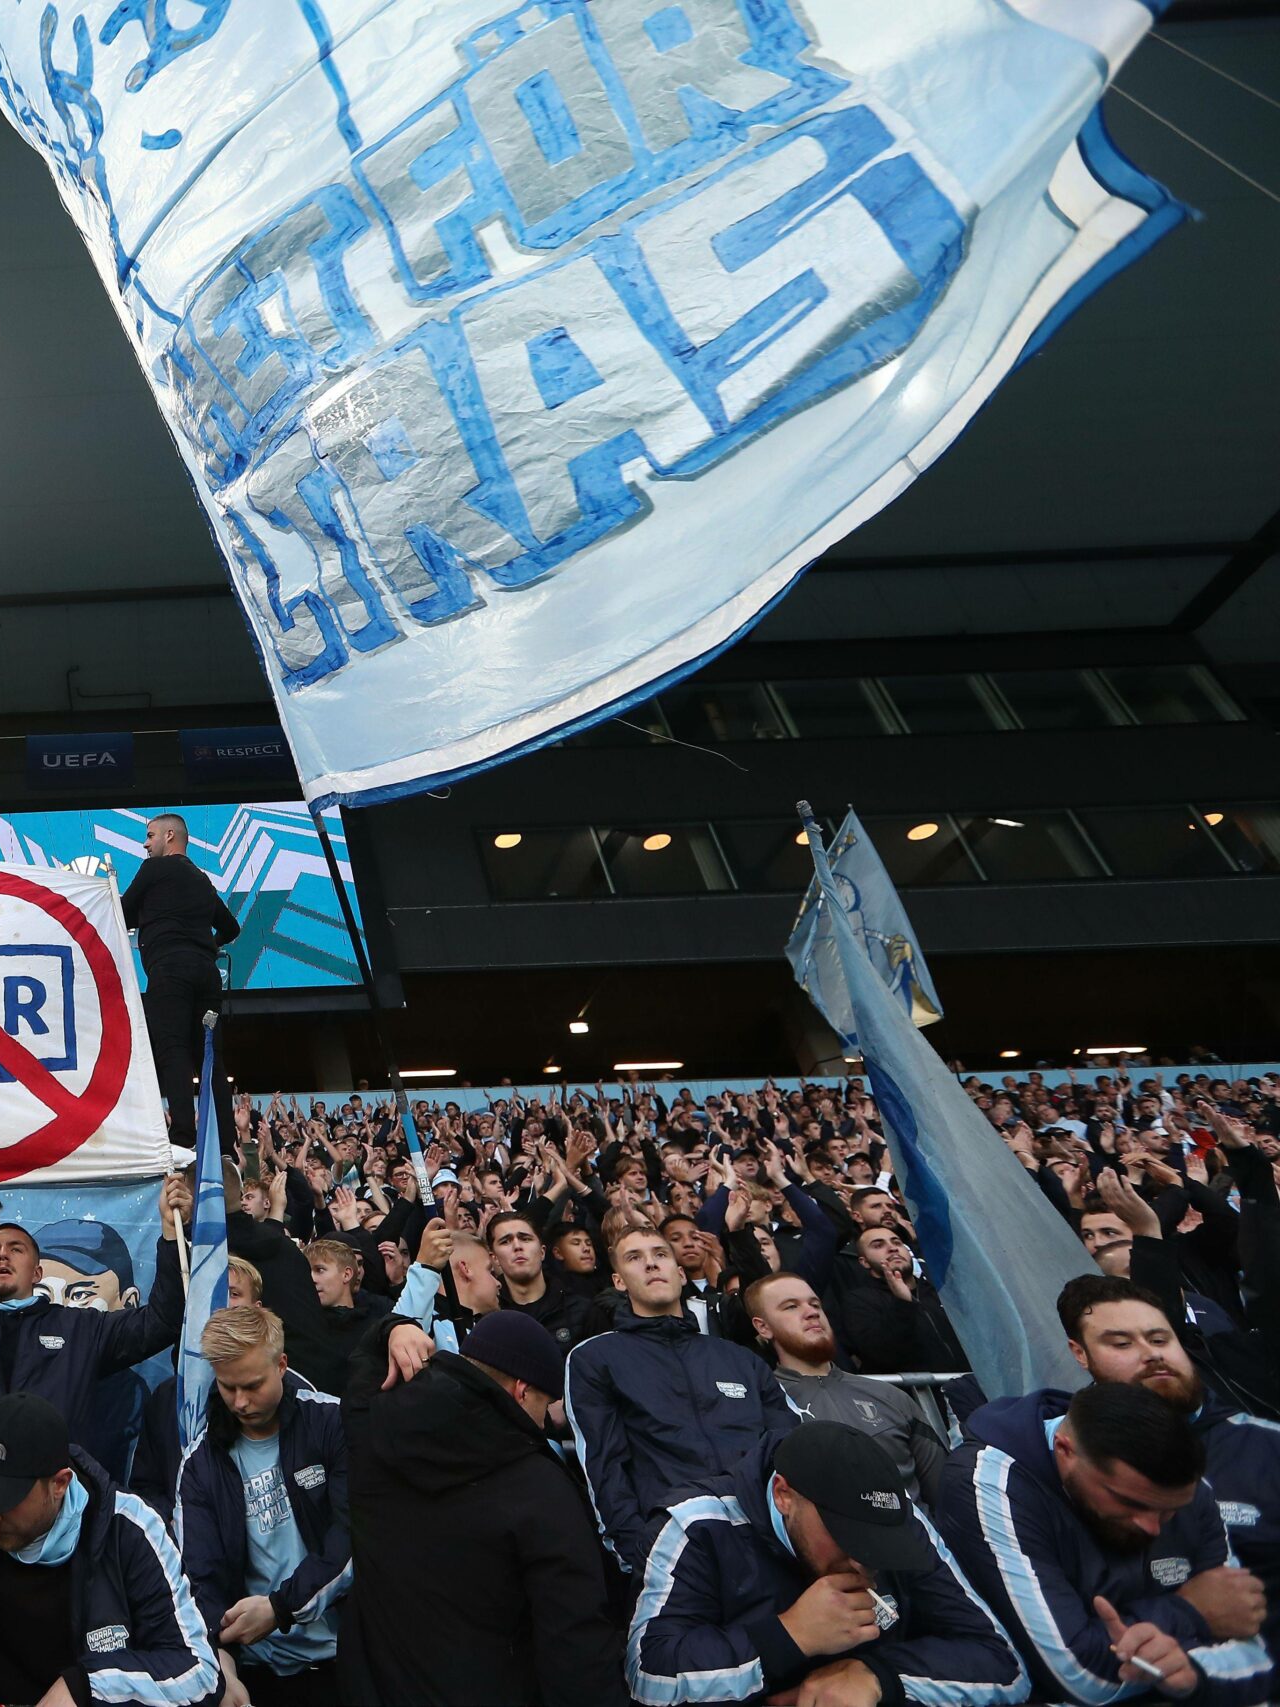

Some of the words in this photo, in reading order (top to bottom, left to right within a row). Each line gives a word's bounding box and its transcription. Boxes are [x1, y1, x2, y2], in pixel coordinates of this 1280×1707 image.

[216, 744, 281, 757] RESPECT
[42, 751, 117, 767] UEFA
[88, 1628, 112, 1643] NORRA
